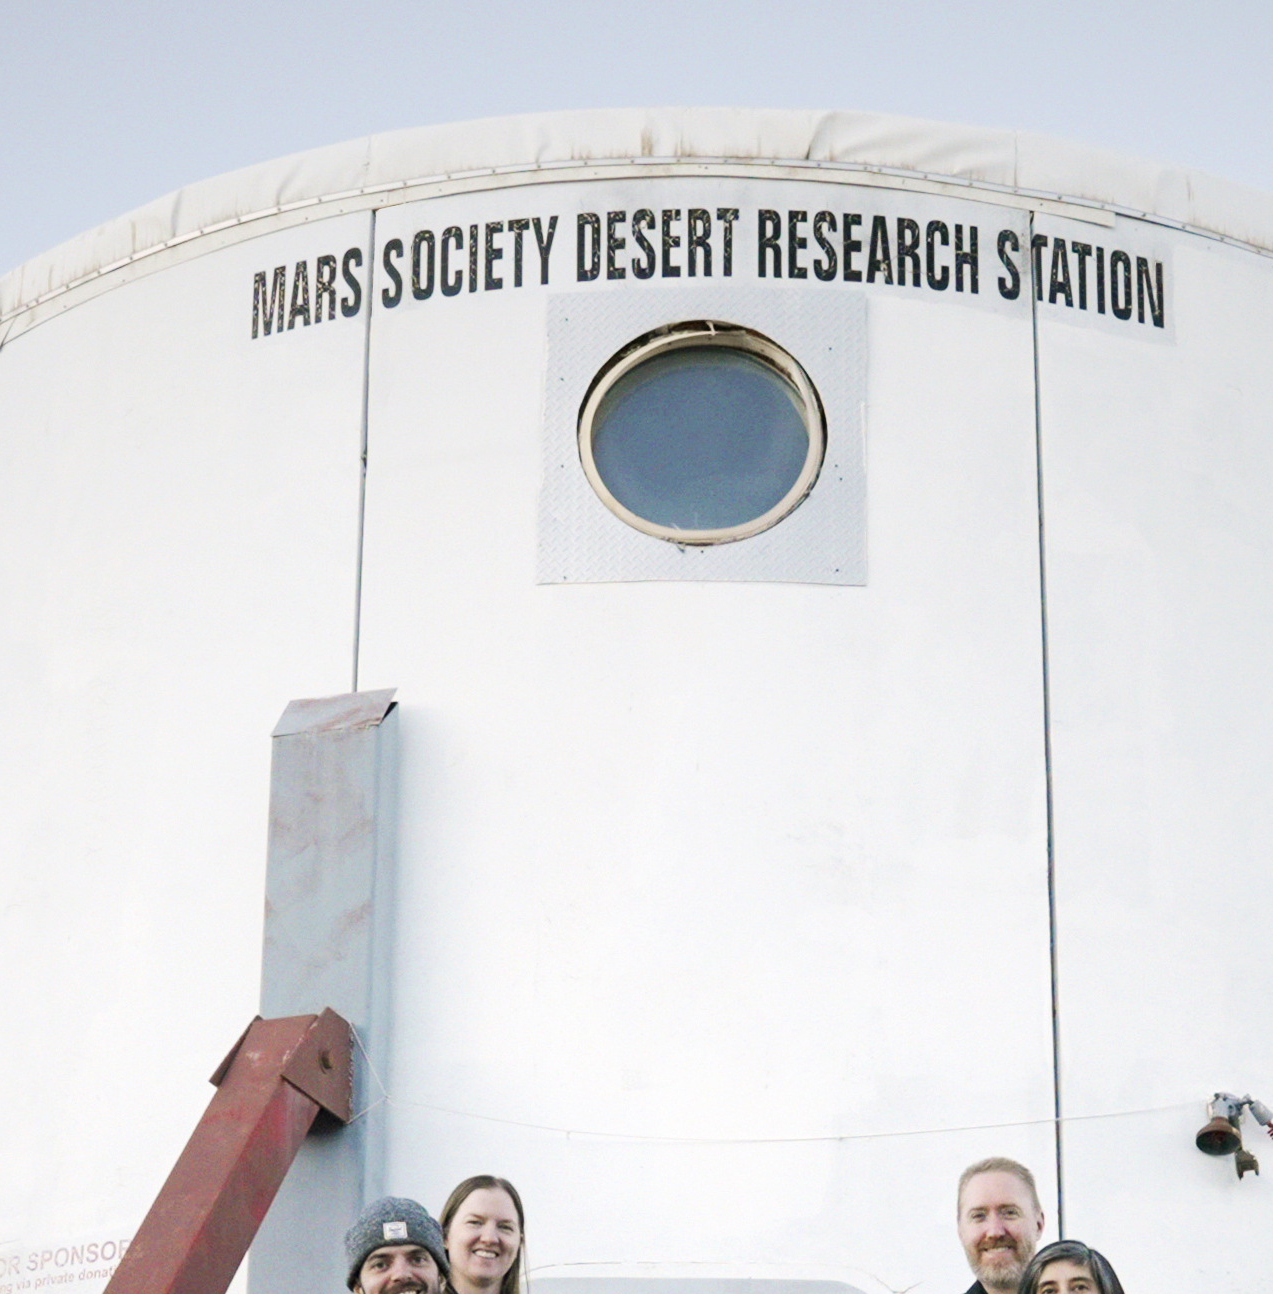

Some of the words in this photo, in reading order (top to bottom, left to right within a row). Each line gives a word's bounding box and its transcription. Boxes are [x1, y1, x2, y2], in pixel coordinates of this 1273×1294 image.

[251, 246, 363, 339] MARS
[382, 215, 558, 309] SOCIETY
[577, 207, 739, 281] DESERT
[758, 209, 979, 294] RESEARCH
[998, 228, 1166, 328] STATION
[34, 1272, 75, 1290] private
[78, 1265, 117, 1282] donat
